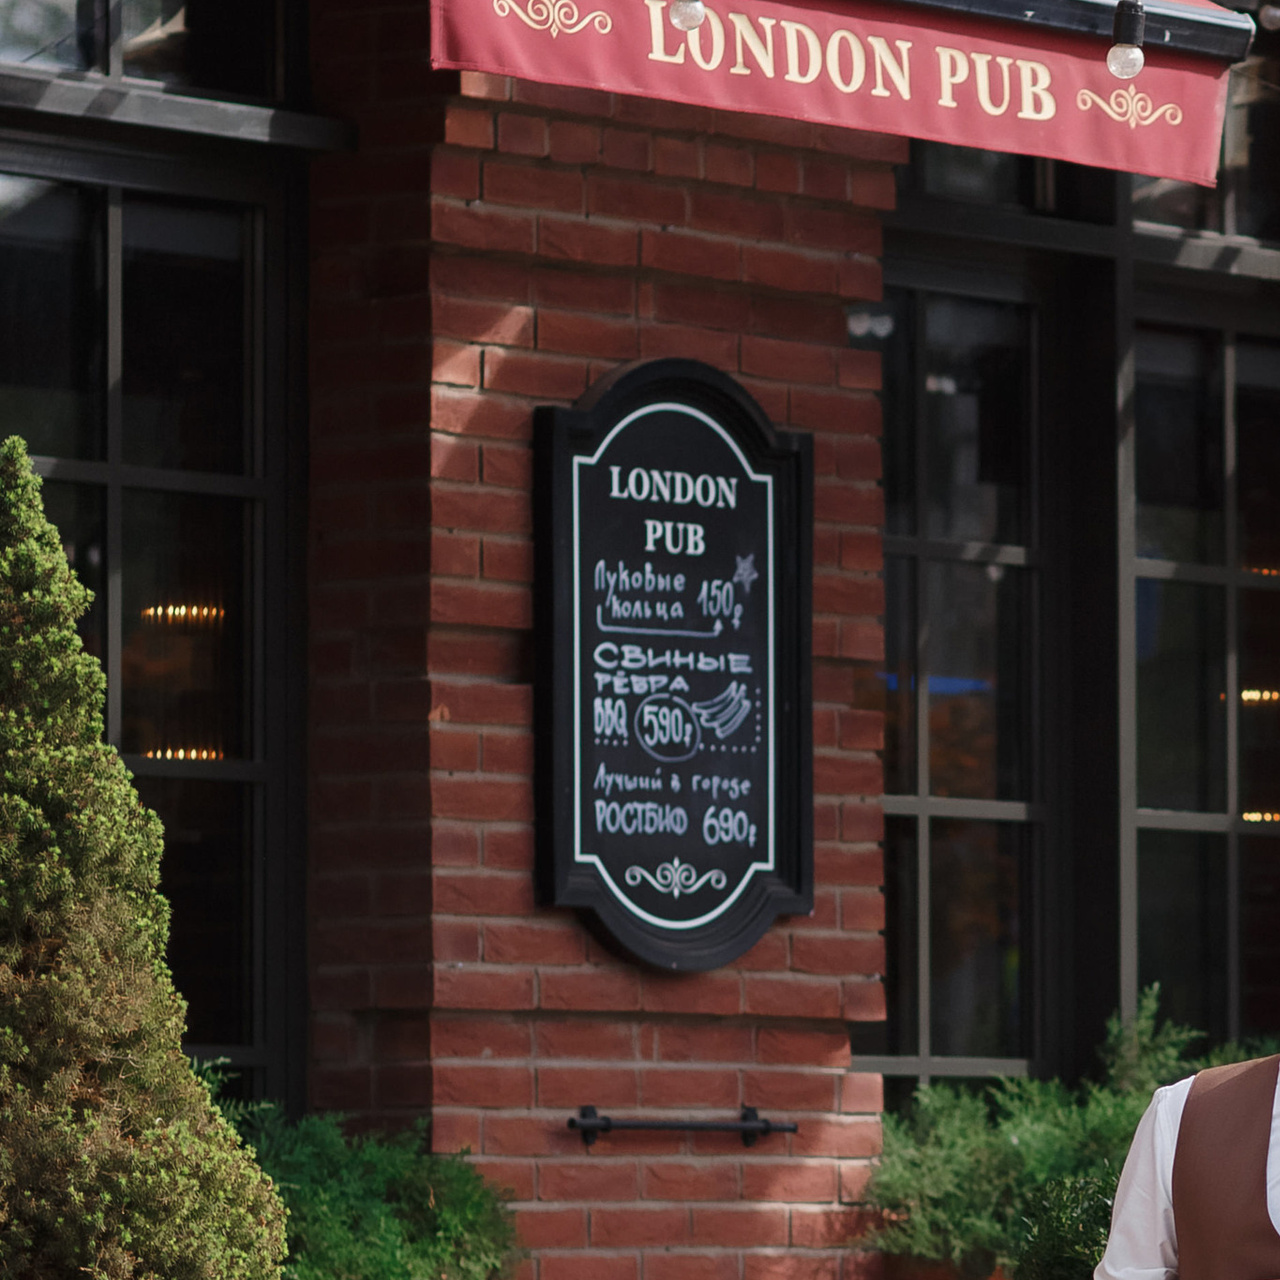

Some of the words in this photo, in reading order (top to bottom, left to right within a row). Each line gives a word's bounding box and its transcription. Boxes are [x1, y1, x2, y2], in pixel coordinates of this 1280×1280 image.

[934, 45, 1058, 121] PUB
[608, 465, 739, 510] LONDON
[644, 519, 706, 556] PUB
[594, 559, 686, 608] Луковые
[593, 641, 753, 674] СВИНЫЕ
[594, 799, 689, 837] РОСТБИФ
